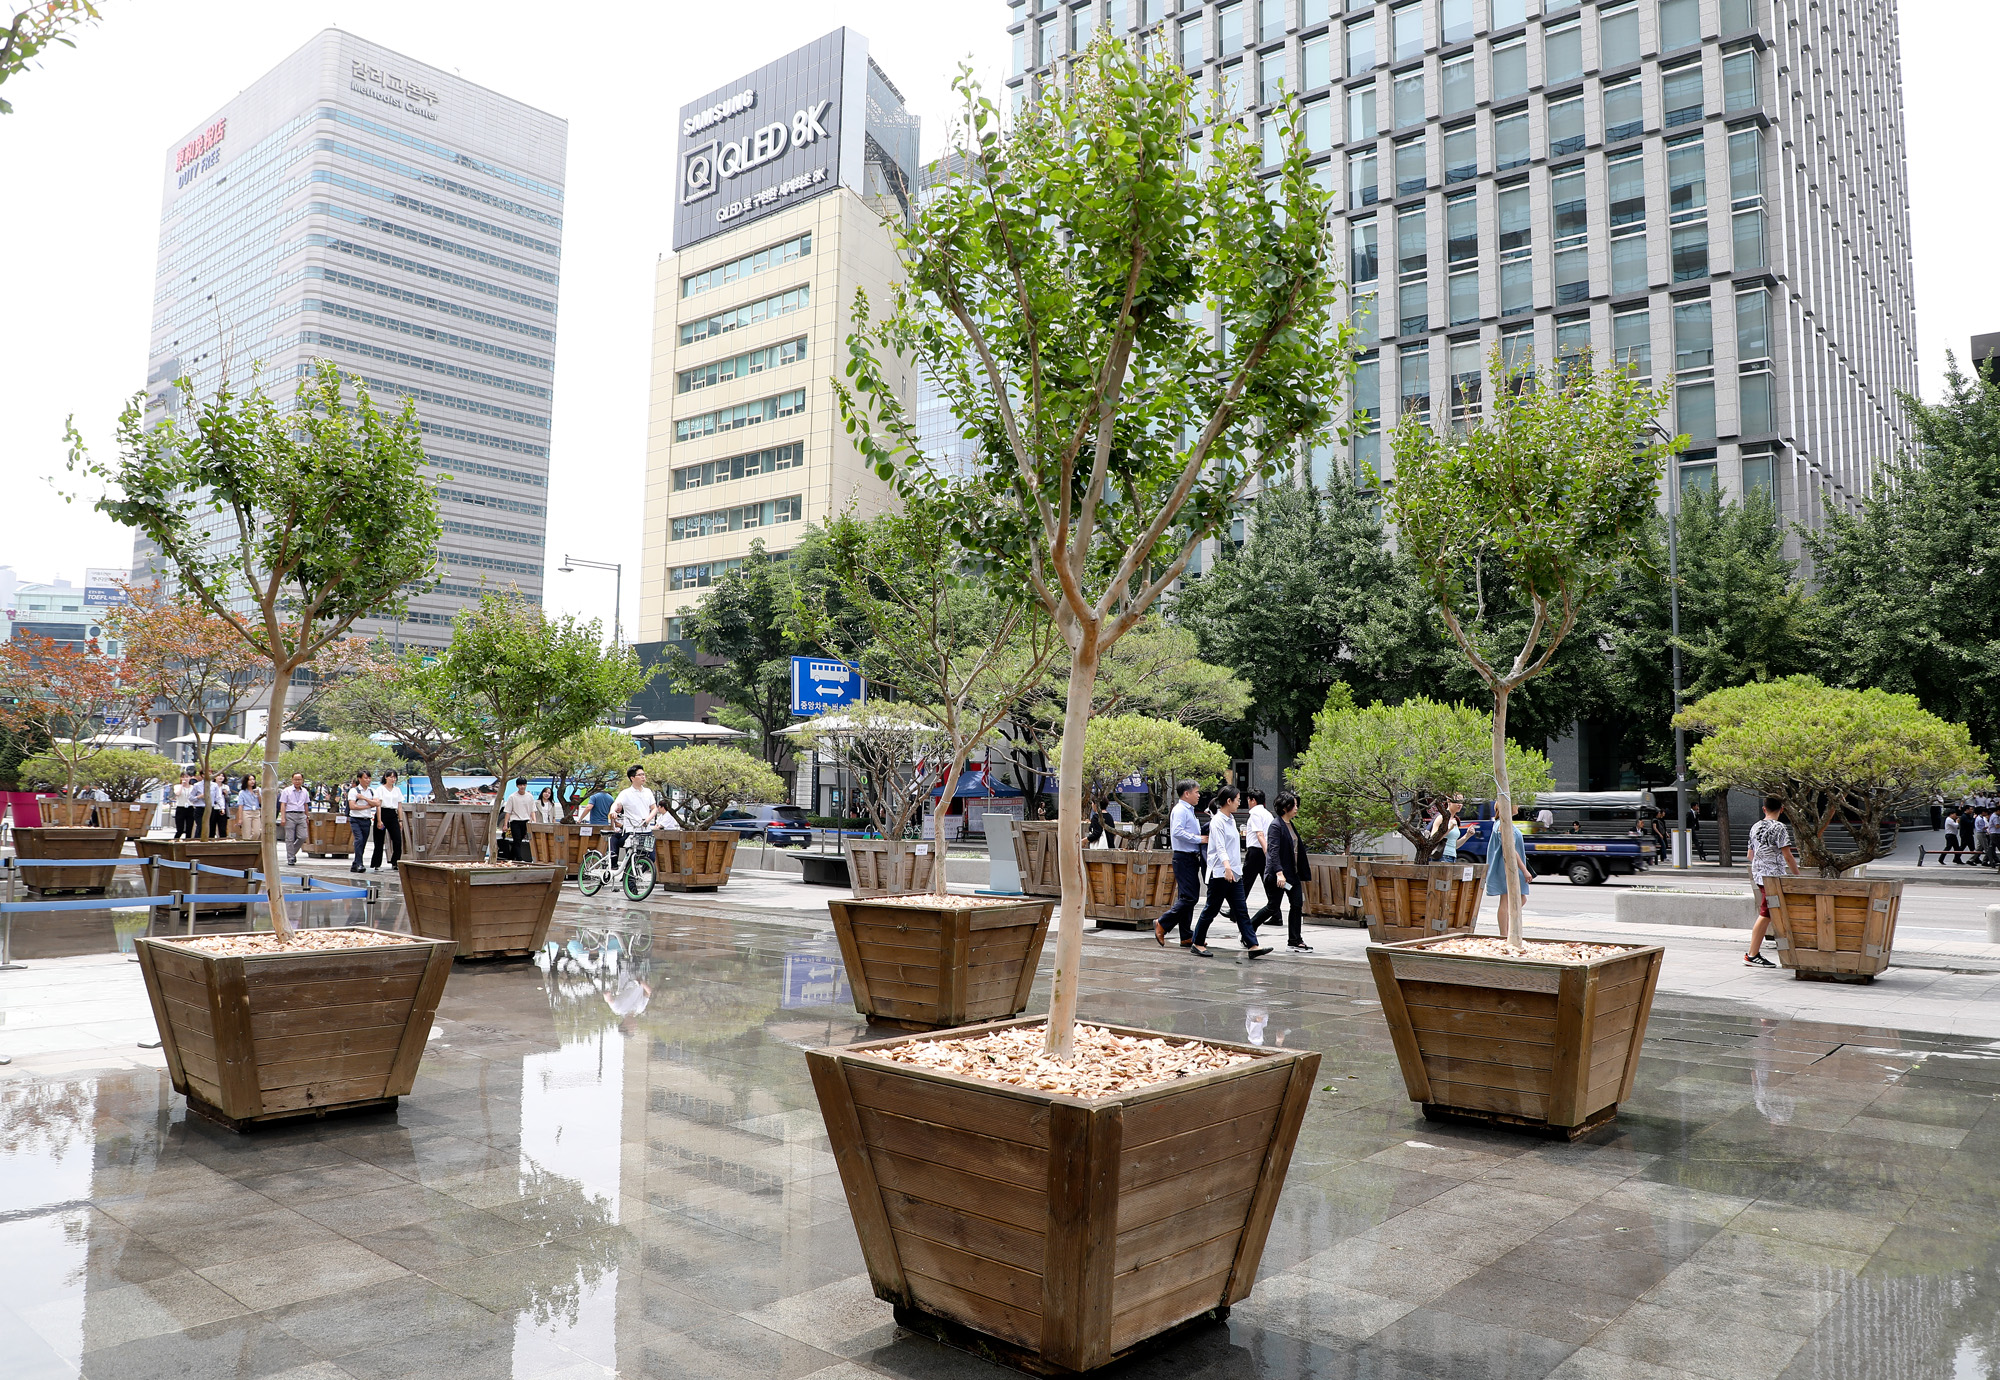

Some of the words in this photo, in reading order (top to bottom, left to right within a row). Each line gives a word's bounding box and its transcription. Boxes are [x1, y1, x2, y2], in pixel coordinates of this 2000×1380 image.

[351, 81, 403, 109] Methodist
[405, 101, 438, 121] Center
[352, 60, 439, 106] 감리교본부
[683, 89, 755, 136] SAMSUNG
[717, 121, 789, 178] QLED
[791, 98, 829, 147] 8K
[178, 162, 200, 189] DUTY
[201, 147, 221, 173] FREE
[812, 167, 827, 182] 8K
